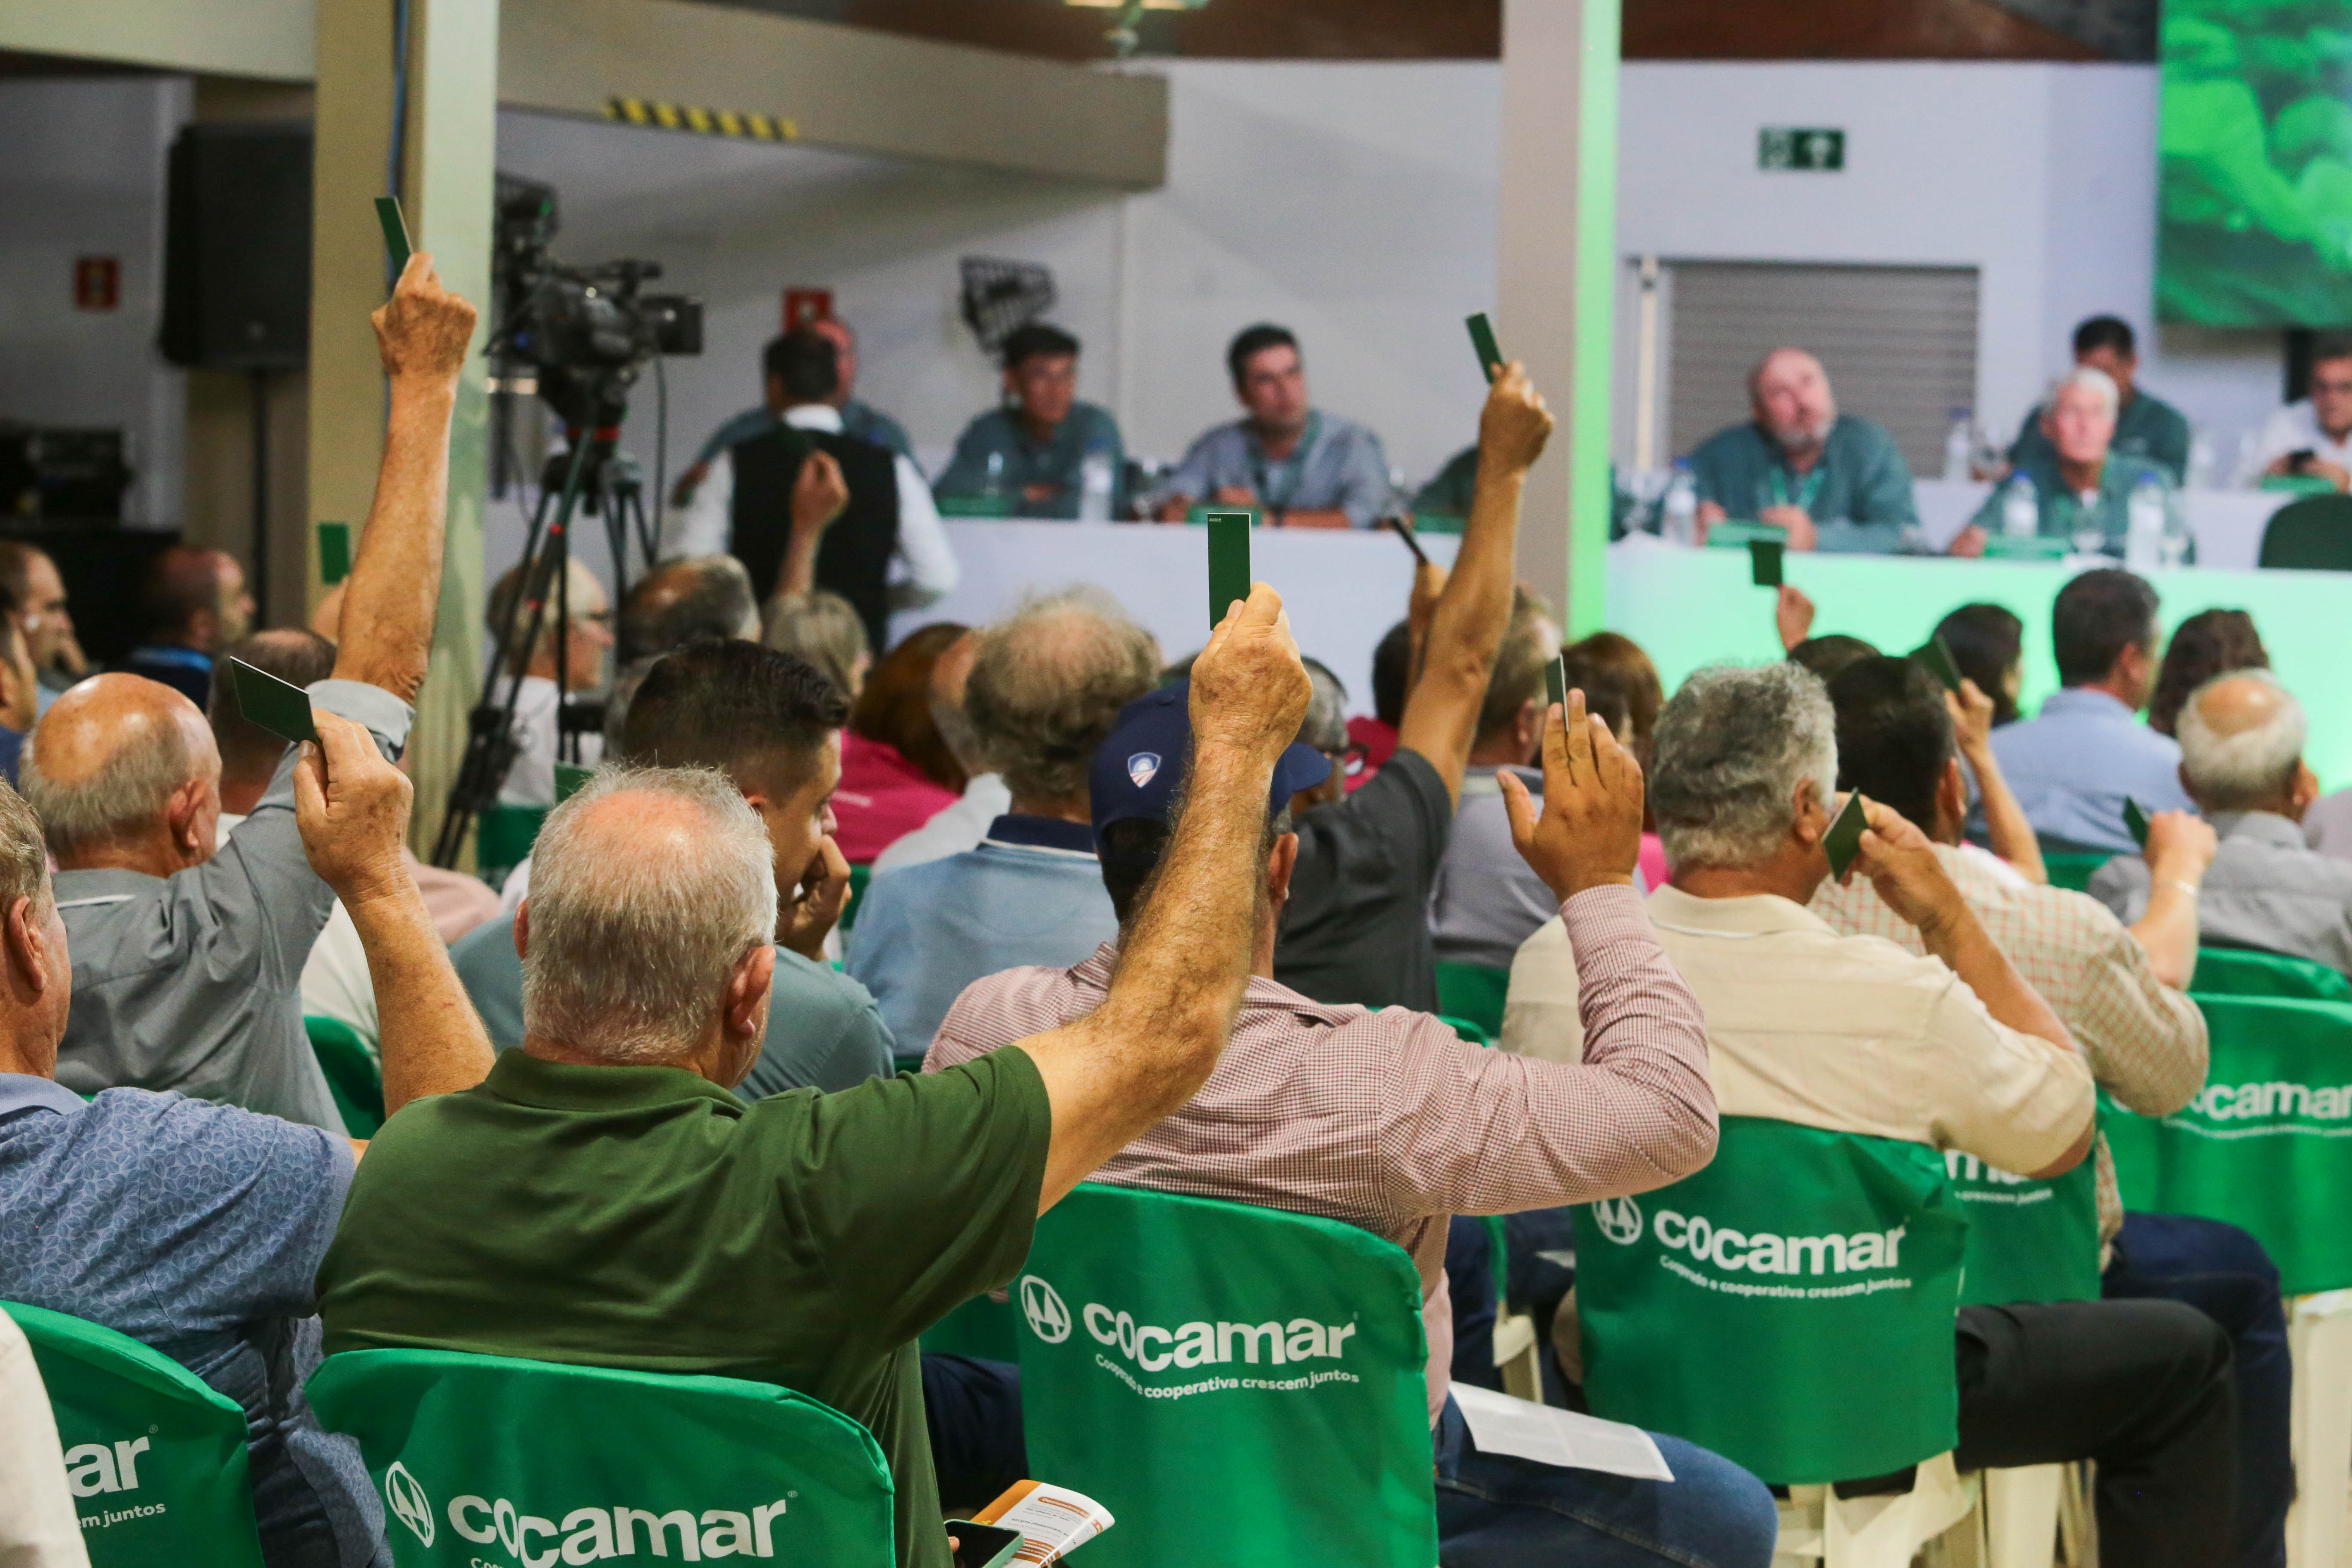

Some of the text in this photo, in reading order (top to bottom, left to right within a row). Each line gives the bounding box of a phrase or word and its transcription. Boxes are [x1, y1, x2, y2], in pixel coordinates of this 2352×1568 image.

[2189, 1081, 2352, 1121] camar
[1654, 1210, 1905, 1275] cocamar
[1083, 1302, 1356, 1372] cocamar
[1144, 1376, 1239, 1400] cooperativa
[1242, 1378, 1308, 1390] crescem
[1310, 1370, 1359, 1389] juntos
[103, 1503, 166, 1528] juntos
[447, 1495, 786, 1568] cocamar
